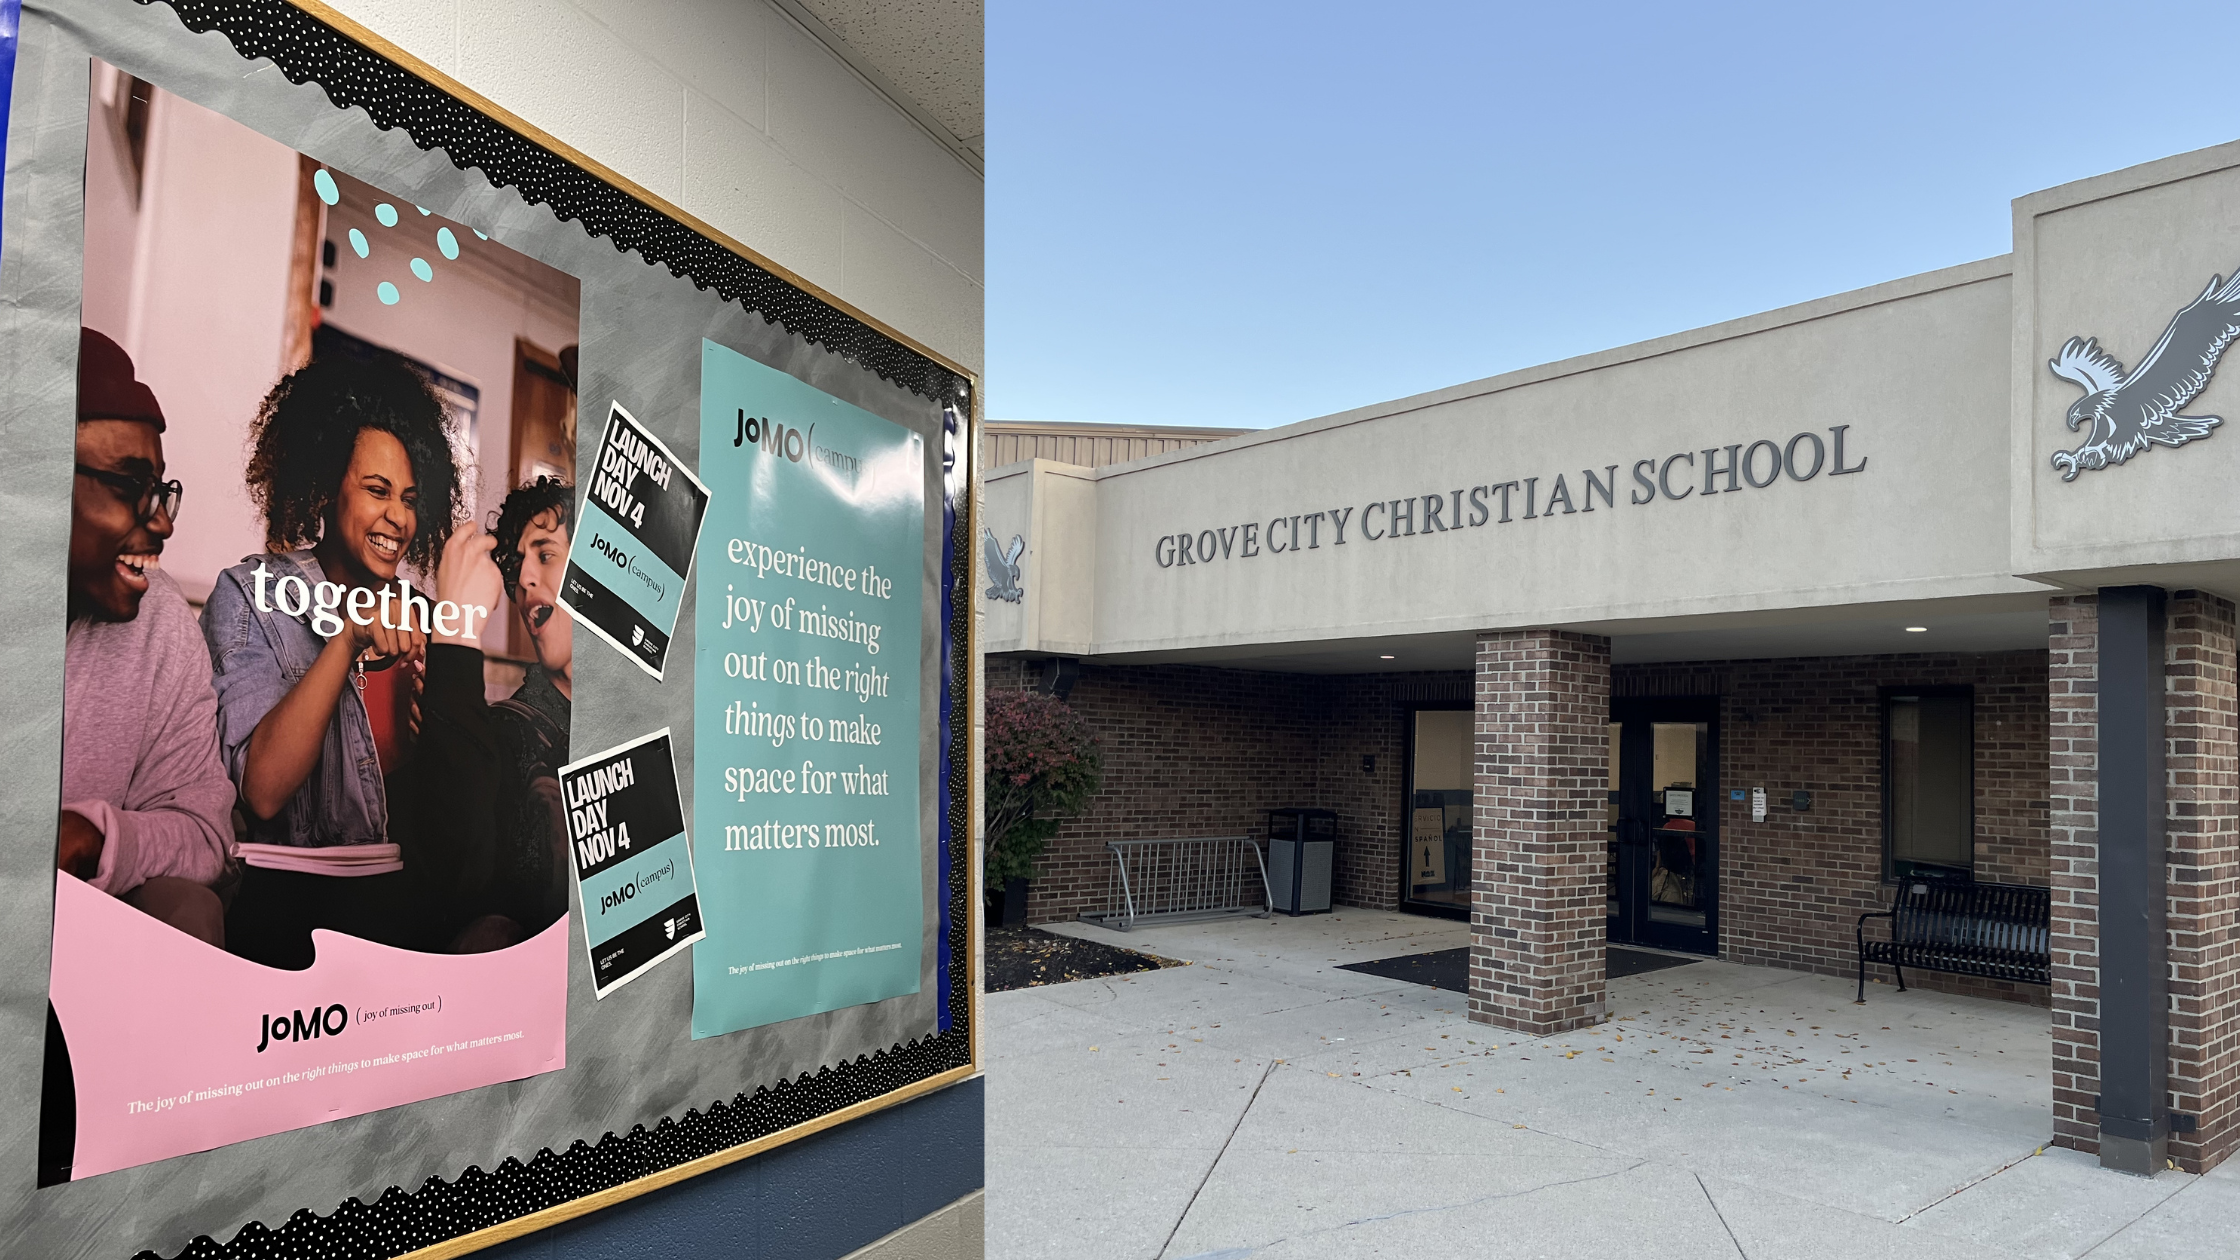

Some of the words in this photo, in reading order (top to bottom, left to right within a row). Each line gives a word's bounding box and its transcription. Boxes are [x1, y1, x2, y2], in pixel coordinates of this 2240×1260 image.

[602, 444, 640, 490] DAY
[609, 419, 672, 492] LAUNCH
[594, 470, 634, 517] NOV
[630, 502, 645, 529] 4
[1156, 522, 1260, 568] GROVE
[1266, 507, 1353, 553] CITY
[1361, 465, 1618, 540] CHRISTIAN
[1632, 425, 1867, 504] SCHOOL
[728, 538, 857, 591] experience
[862, 566, 892, 599] the
[250, 562, 488, 640] together
[722, 584, 766, 633] joy
[771, 597, 795, 630] of
[799, 604, 881, 655] missing
[724, 652, 767, 681] out
[773, 659, 800, 686] on
[806, 656, 840, 691] the
[845, 662, 889, 703] right
[725, 701, 796, 747] things
[801, 712, 823, 740] to
[829, 714, 882, 746] make
[567, 758, 634, 809] LAUNCH
[724, 766, 796, 802] space
[801, 760, 836, 794] for
[841, 764, 889, 795] what
[572, 799, 607, 839] DAY
[724, 820, 820, 851] matters
[824, 819, 879, 848] most.
[1415, 834, 1442, 842] SPAÑOL
[578, 827, 615, 869] NOV
[618, 822, 630, 849] 4
[728, 966, 739, 974] The
[739, 965, 748, 975] joy
[749, 963, 755, 971] of
[755, 961, 775, 970] missing
[800, 955, 810, 964] right
[379, 1007, 388, 1018] of
[390, 1003, 420, 1016] missing
[127, 1101, 153, 1114] The
[155, 1096, 177, 1112] joy
[179, 1090, 193, 1105] of
[195, 1083, 243, 1101] missing
[245, 1078, 264, 1091] out
[266, 1076, 280, 1087] on
[282, 1069, 300, 1084] the
[301, 1066, 326, 1081] right
[328, 1059, 359, 1073] things
[361, 1060, 371, 1068] to
[373, 1053, 400, 1066] make
[402, 1049, 429, 1062] space
[430, 1045, 444, 1056] for
[446, 1041, 468, 1052] what
[470, 1035, 502, 1048] matters
[503, 1030, 525, 1042] most.
